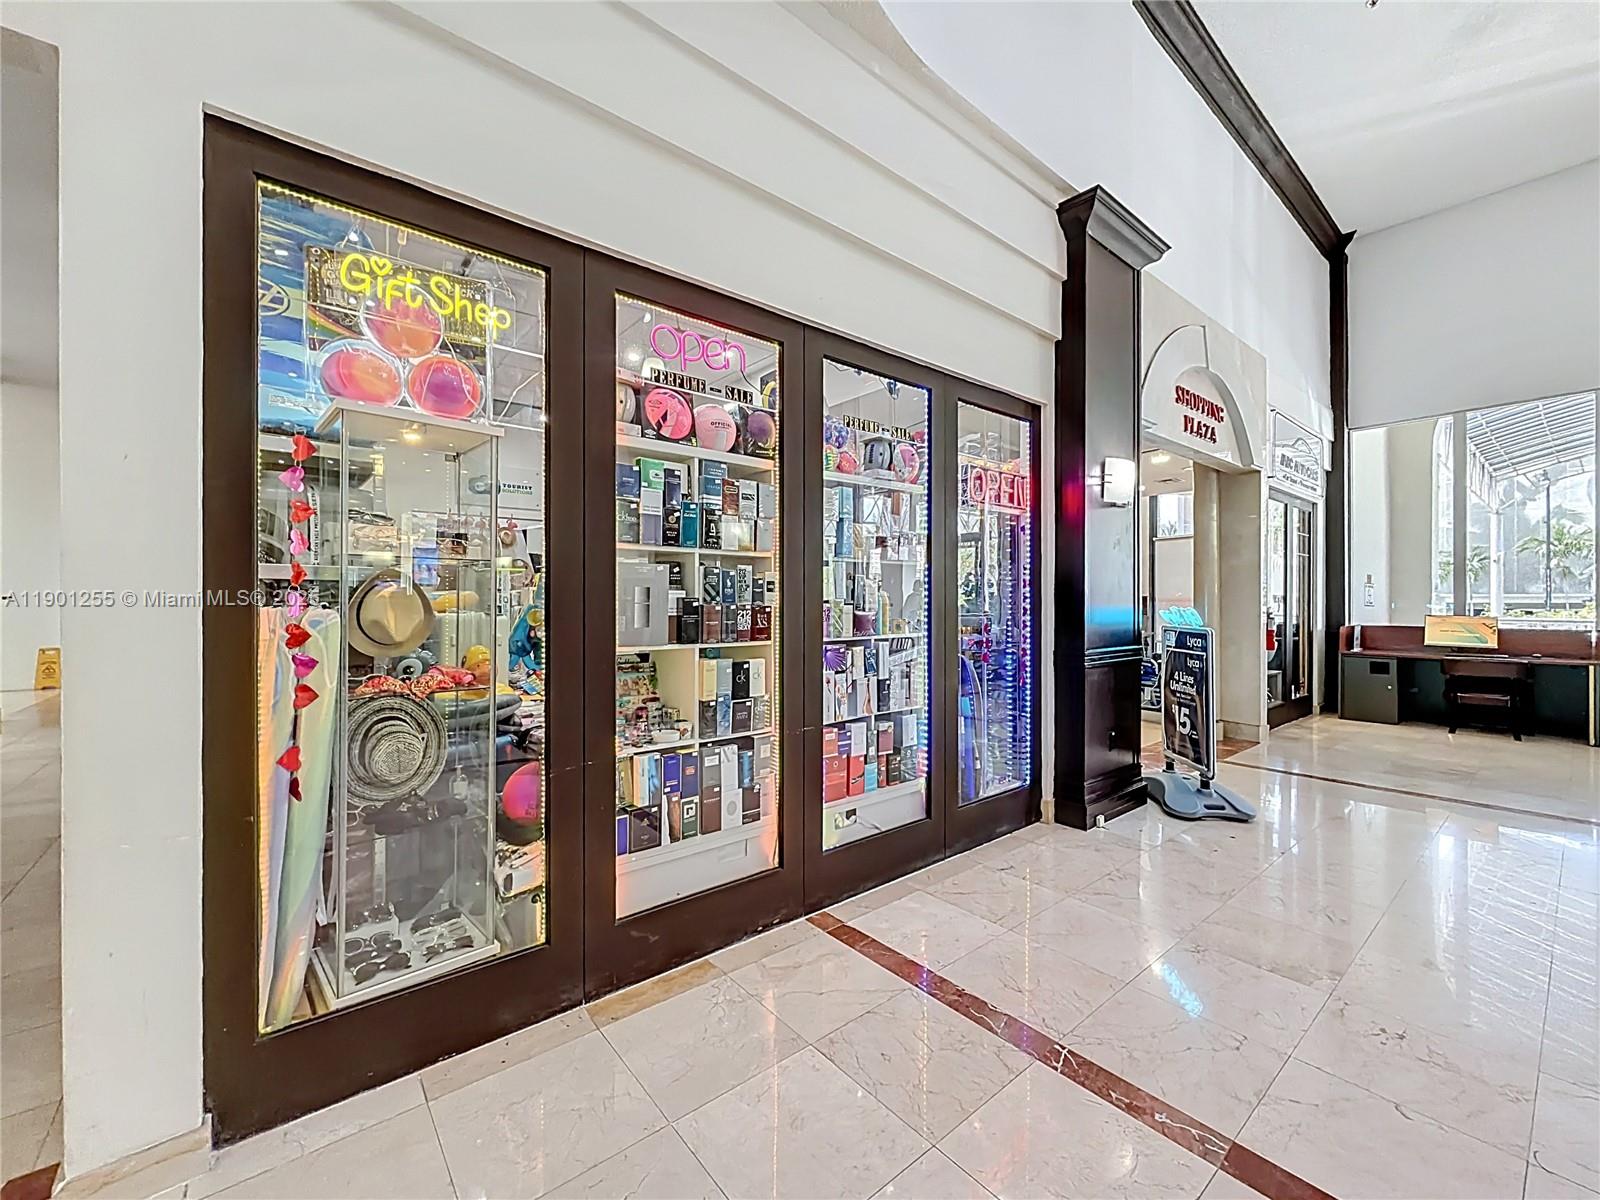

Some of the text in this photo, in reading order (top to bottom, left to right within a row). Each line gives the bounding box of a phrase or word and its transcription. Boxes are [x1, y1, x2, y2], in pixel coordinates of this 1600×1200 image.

[340, 253, 422, 310] Gift
[651, 323, 746, 372] open
[651, 368, 753, 405] PERFUME SALE
[1174, 385, 1224, 424] SHOPPING
[843, 414, 911, 442] PERFUME SALE
[1183, 414, 1217, 445] PLAZA
[502, 483, 533, 491] TOURIST
[970, 466, 1028, 510] OPEN
[1186, 635, 1202, 648] Lyca
[735, 669, 747, 684] ck
[1173, 670, 1195, 684] 4 Lines
[1186, 657, 1200, 669] Lyca
[1169, 679, 1197, 696] Unlimited
